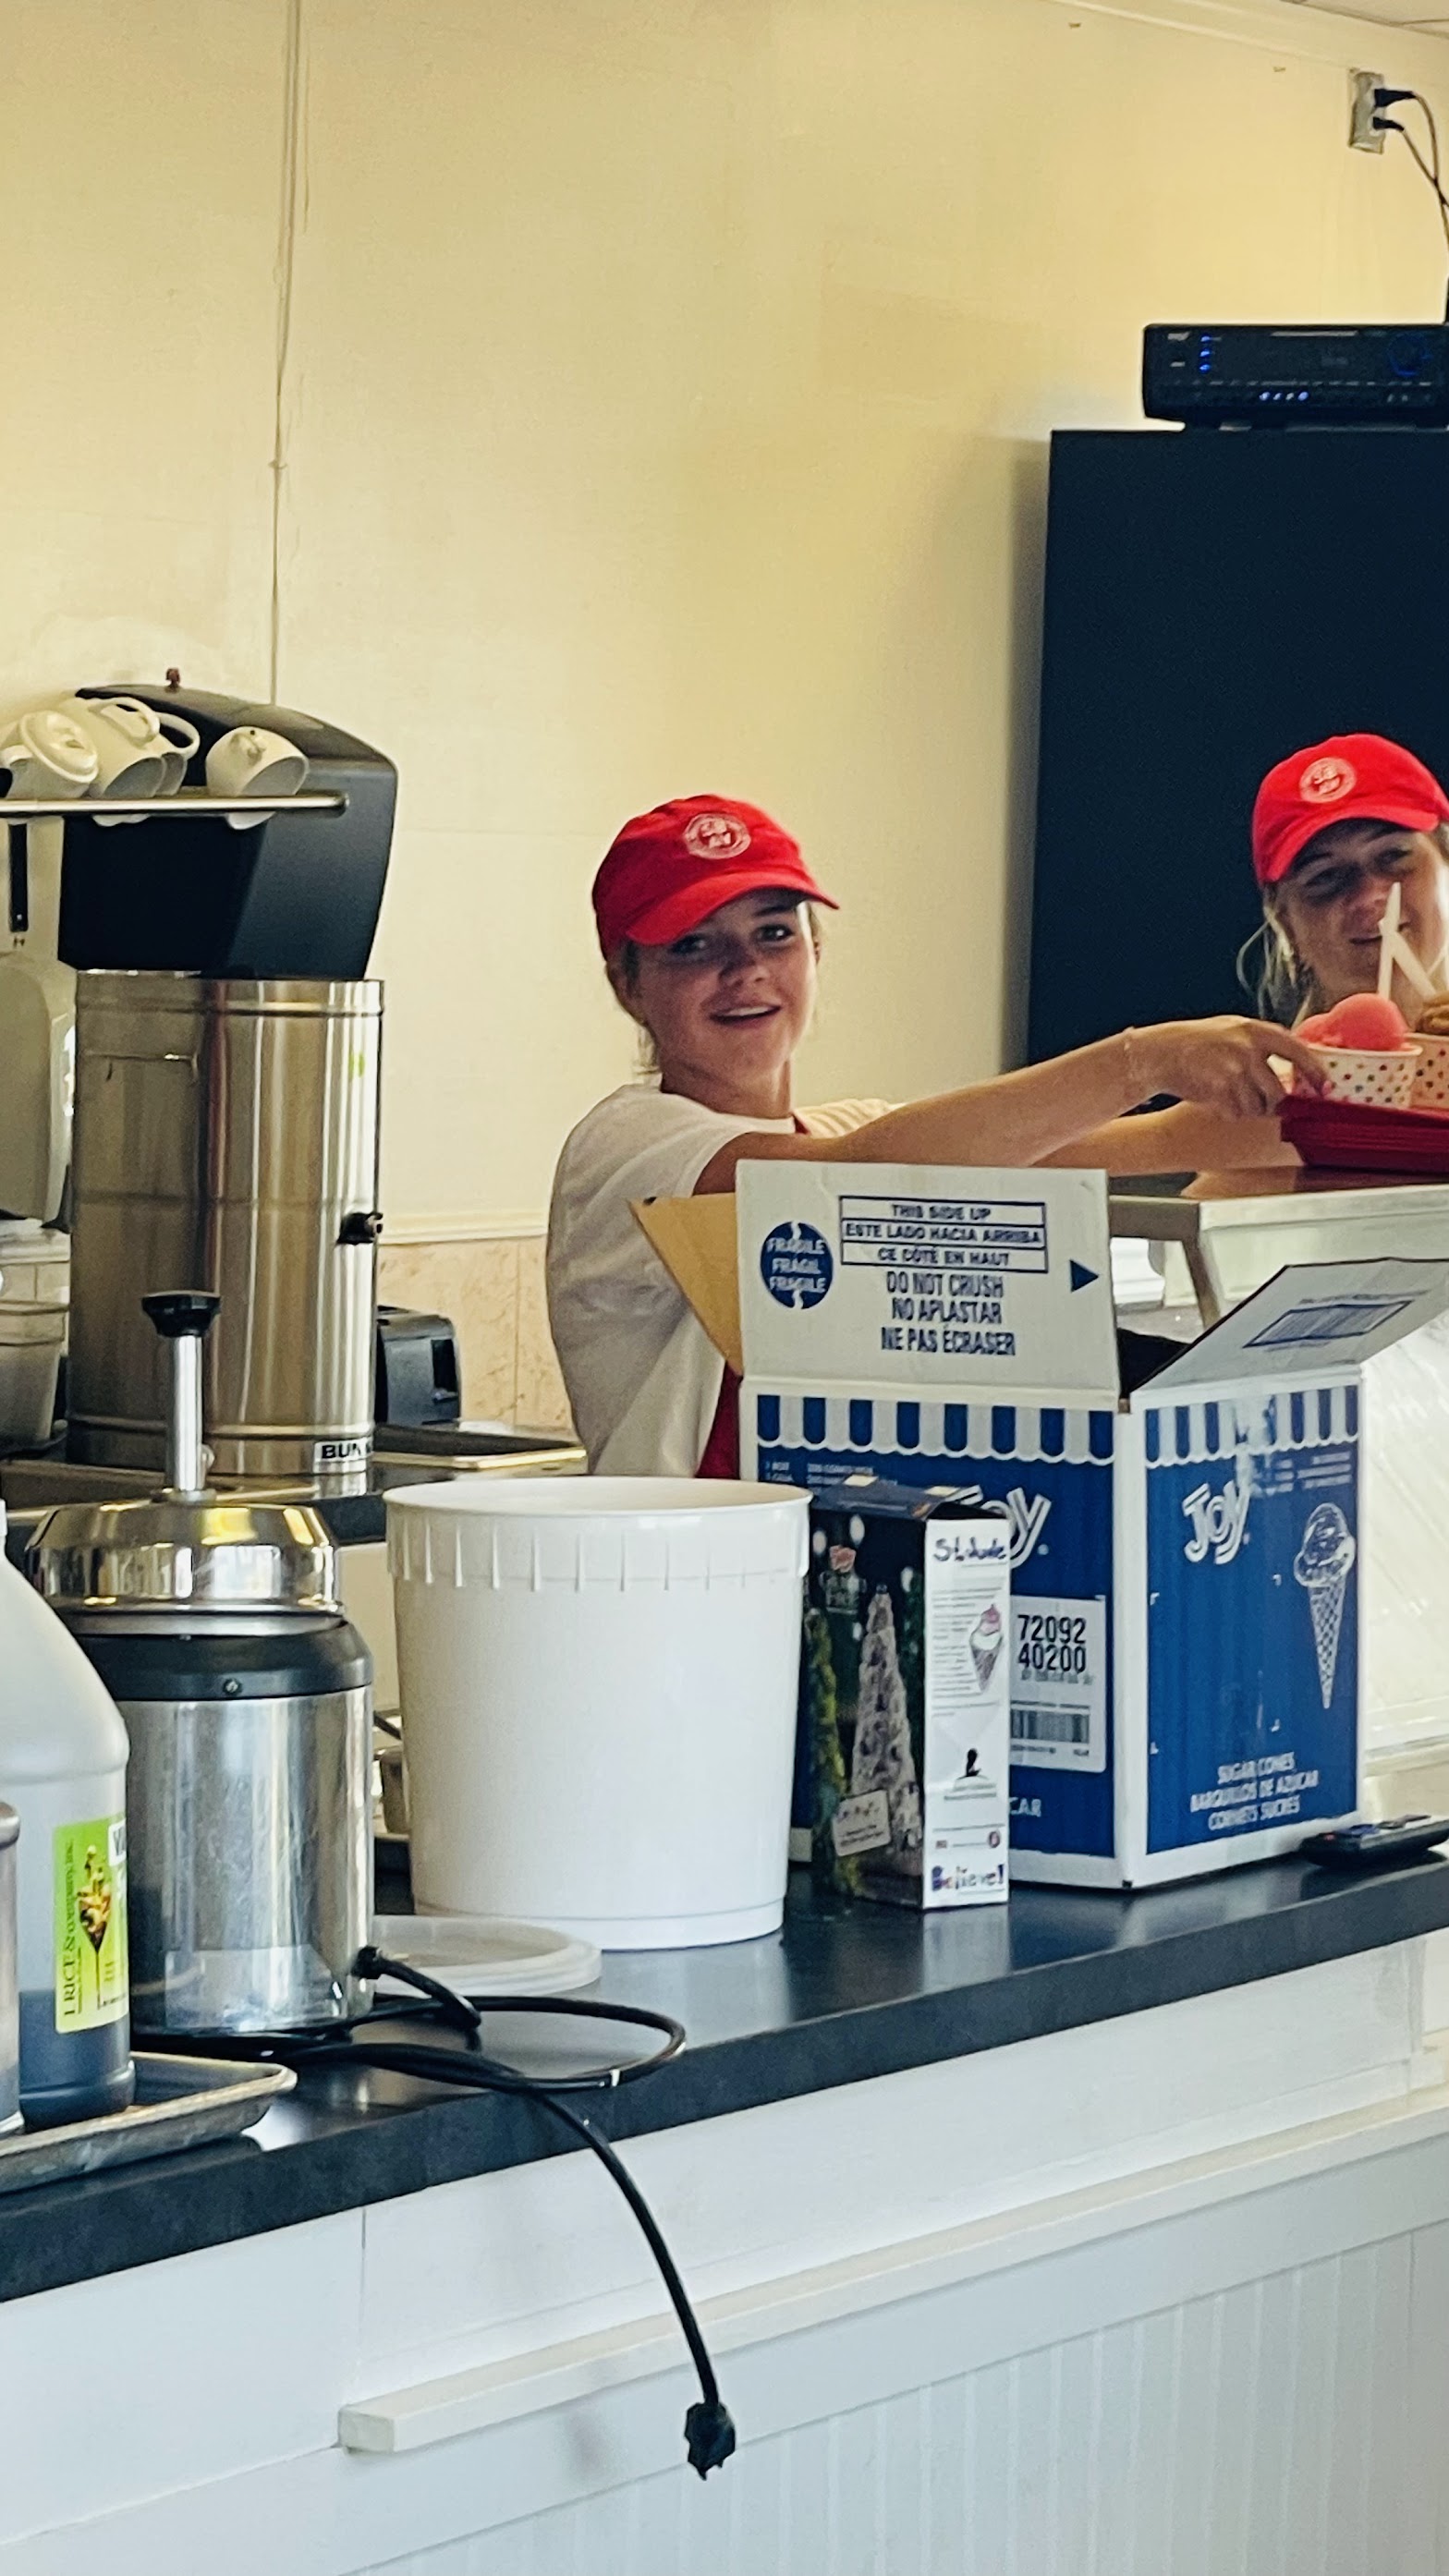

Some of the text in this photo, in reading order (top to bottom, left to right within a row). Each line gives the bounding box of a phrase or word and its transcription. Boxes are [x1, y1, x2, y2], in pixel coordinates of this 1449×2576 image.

[892, 1204, 991, 1221] THIS SIDE UP
[766, 1237, 825, 1254] FRAGILE
[846, 1222, 882, 1238] ESTE
[886, 1224, 925, 1239] LADO
[930, 1226, 978, 1242] HACIA
[878, 1247, 896, 1261] CE
[944, 1250, 966, 1264] EN
[969, 1252, 1009, 1267] HAUT
[886, 1270, 1004, 1298] DO NOT CRUSH
[892, 1297, 1002, 1324] NO APLASTAR
[882, 1326, 903, 1350] NE
[907, 1328, 938, 1353] PAS
[1017, 1614, 1086, 1644] 72092
[1017, 1642, 1086, 1674] 40200
